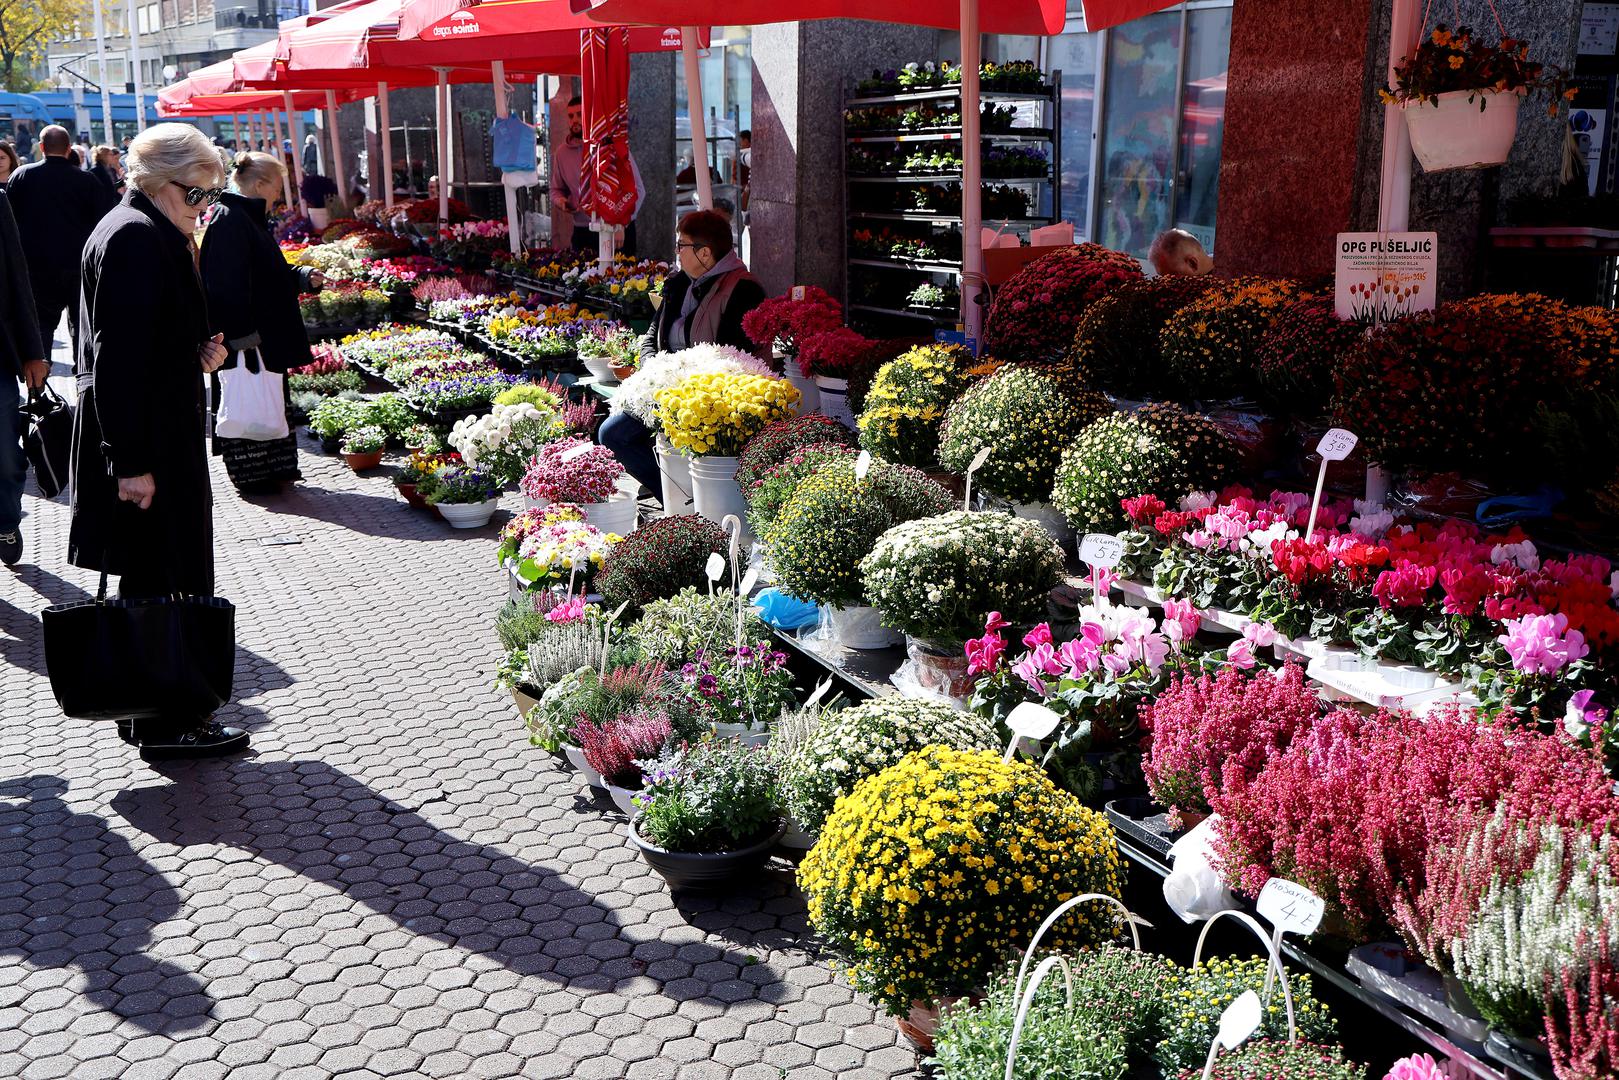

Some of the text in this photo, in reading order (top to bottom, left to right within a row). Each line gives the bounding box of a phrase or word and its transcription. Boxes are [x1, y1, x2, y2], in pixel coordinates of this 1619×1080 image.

[1342, 239, 1431, 253] OPG PUŠELJIĆ
[1094, 546, 1109, 559] 5
[1280, 900, 1297, 920] 4
